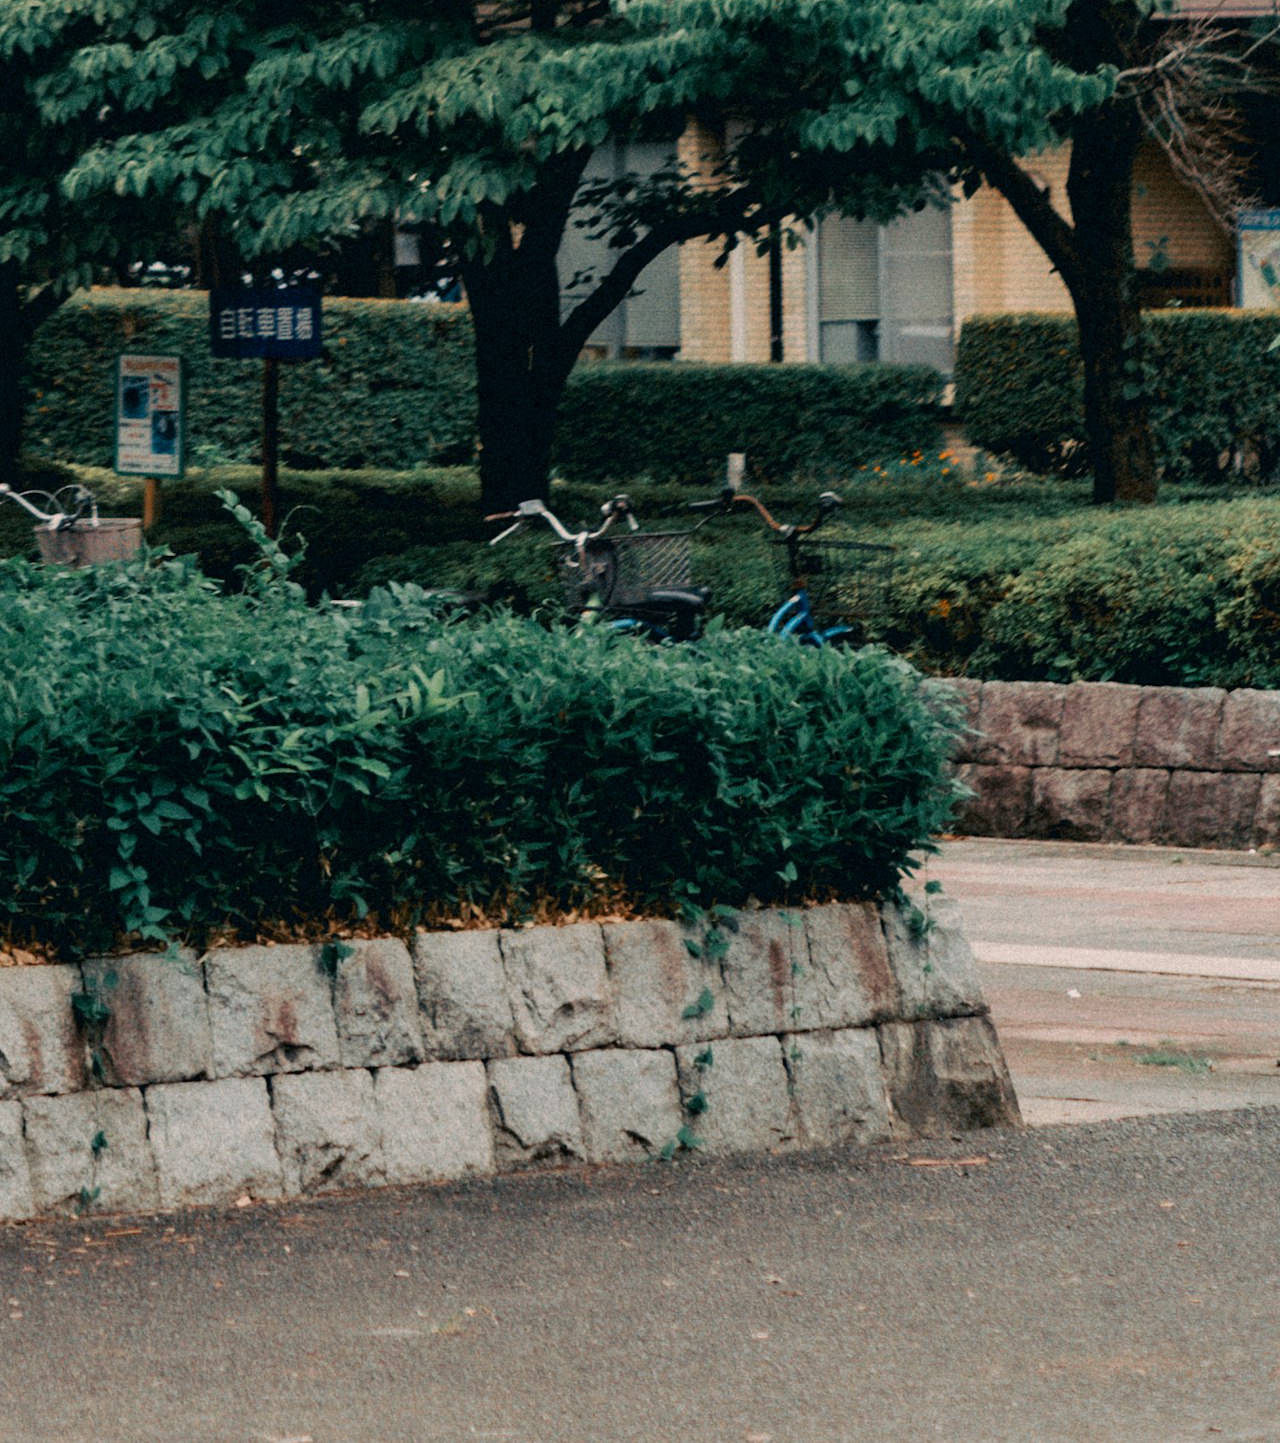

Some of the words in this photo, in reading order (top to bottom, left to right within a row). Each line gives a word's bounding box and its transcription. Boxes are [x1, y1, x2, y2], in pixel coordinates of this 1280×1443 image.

[220, 307, 313, 340] 自転車置場
